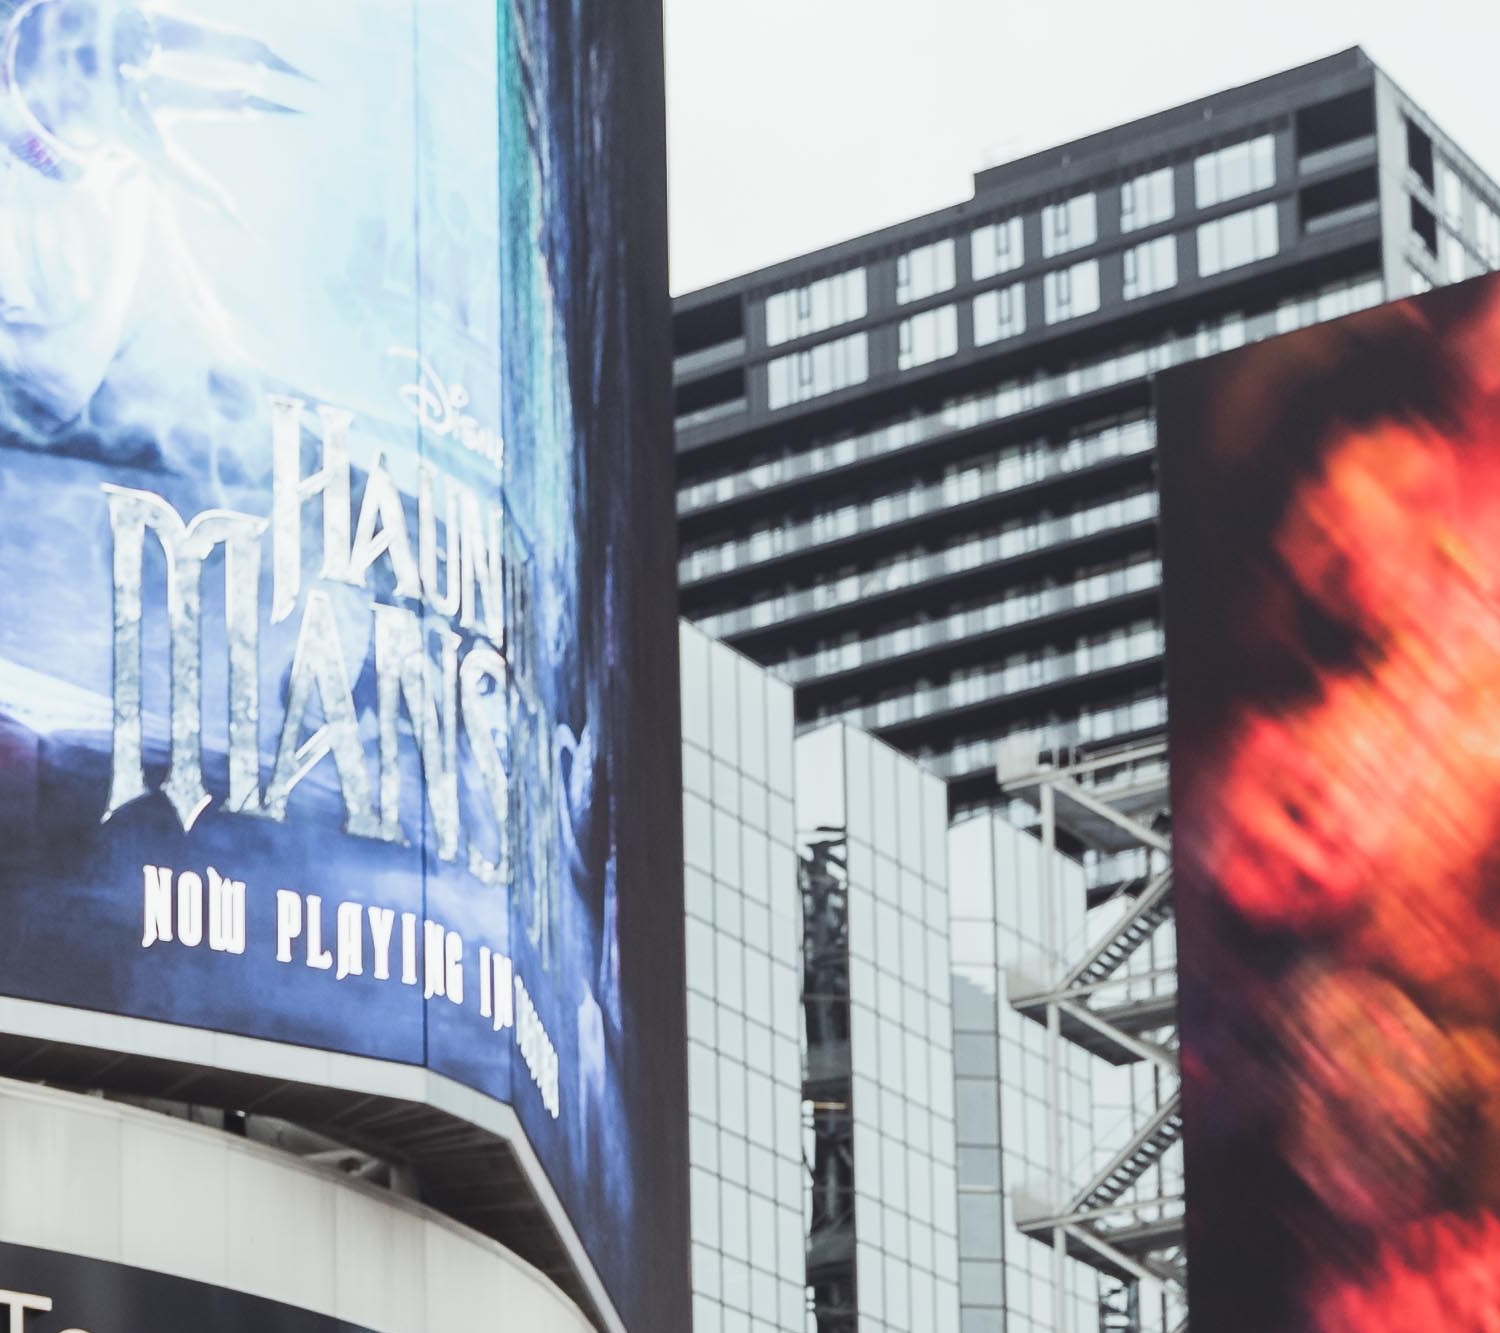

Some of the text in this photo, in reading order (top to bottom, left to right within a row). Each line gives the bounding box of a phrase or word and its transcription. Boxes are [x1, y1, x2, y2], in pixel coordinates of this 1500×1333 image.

[270, 392, 508, 650] HAUN
[100, 481, 520, 888] MANS
[141, 864, 514, 1031] NOW PLAYING IN
